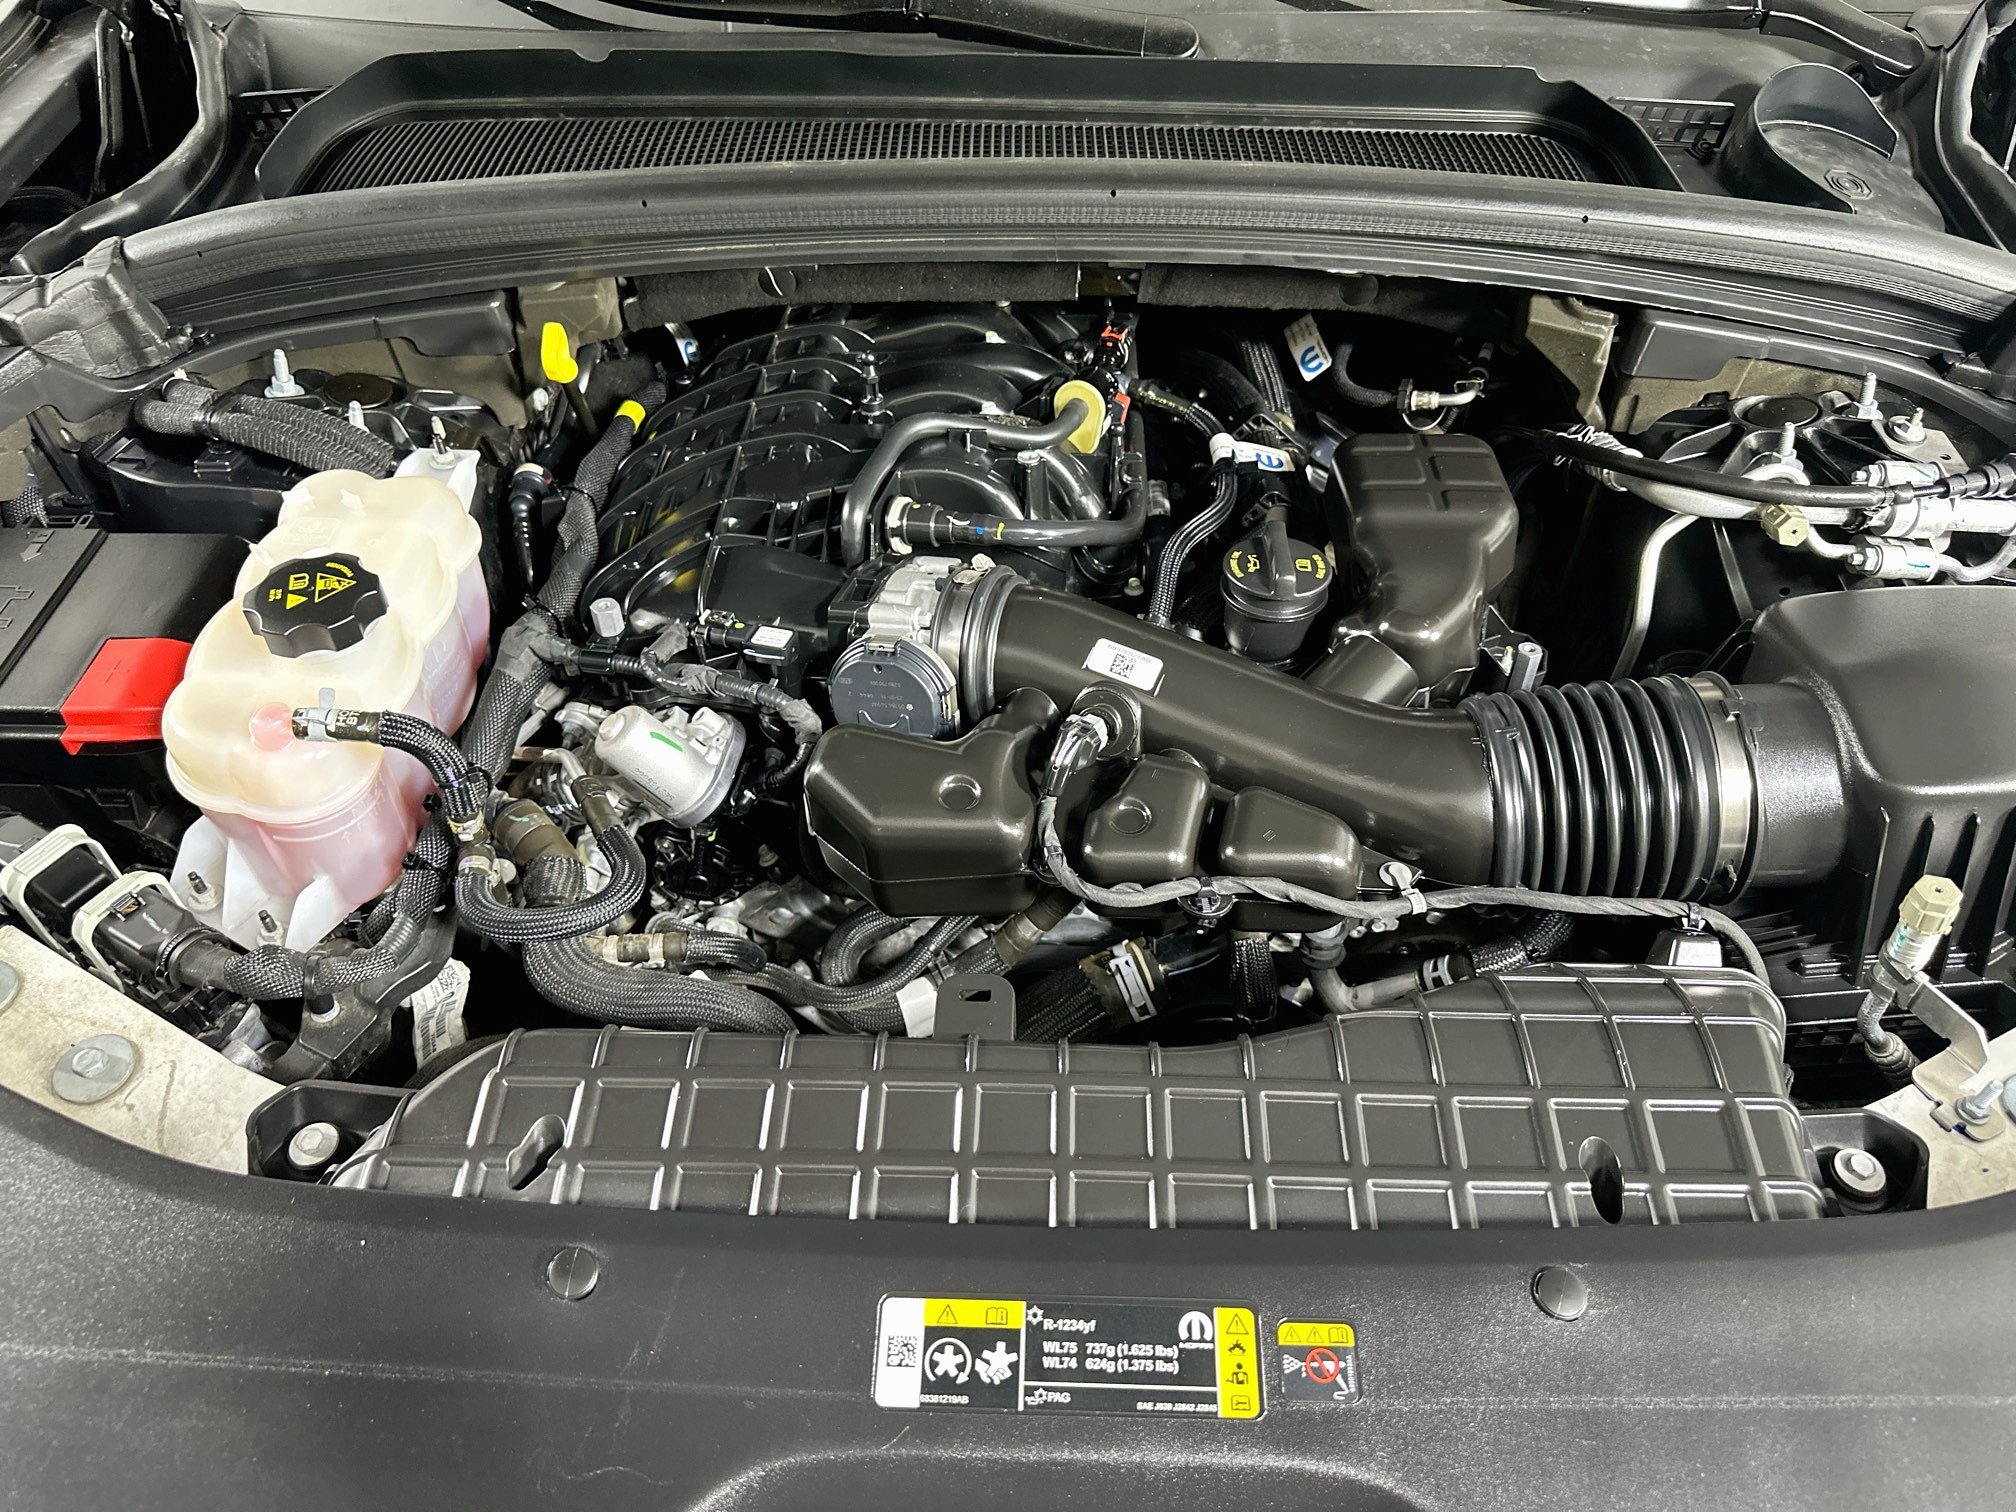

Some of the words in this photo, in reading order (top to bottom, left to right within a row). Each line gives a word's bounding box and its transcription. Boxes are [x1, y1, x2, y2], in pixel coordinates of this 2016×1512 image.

[1043, 1318, 1097, 1334] R-1234yf
[1042, 1340, 1078, 1354] WL75
[1085, 1342, 1116, 1357] 737g
[1117, 1343, 1154, 1358] (1.625
[1154, 1344, 1179, 1359] lbs)
[1042, 1356, 1078, 1369] WL74
[1085, 1357, 1116, 1373] 624g
[1117, 1358, 1154, 1373] (1.375
[1155, 1359, 1180, 1374] lbs)
[1047, 1391, 1072, 1404] PAG
